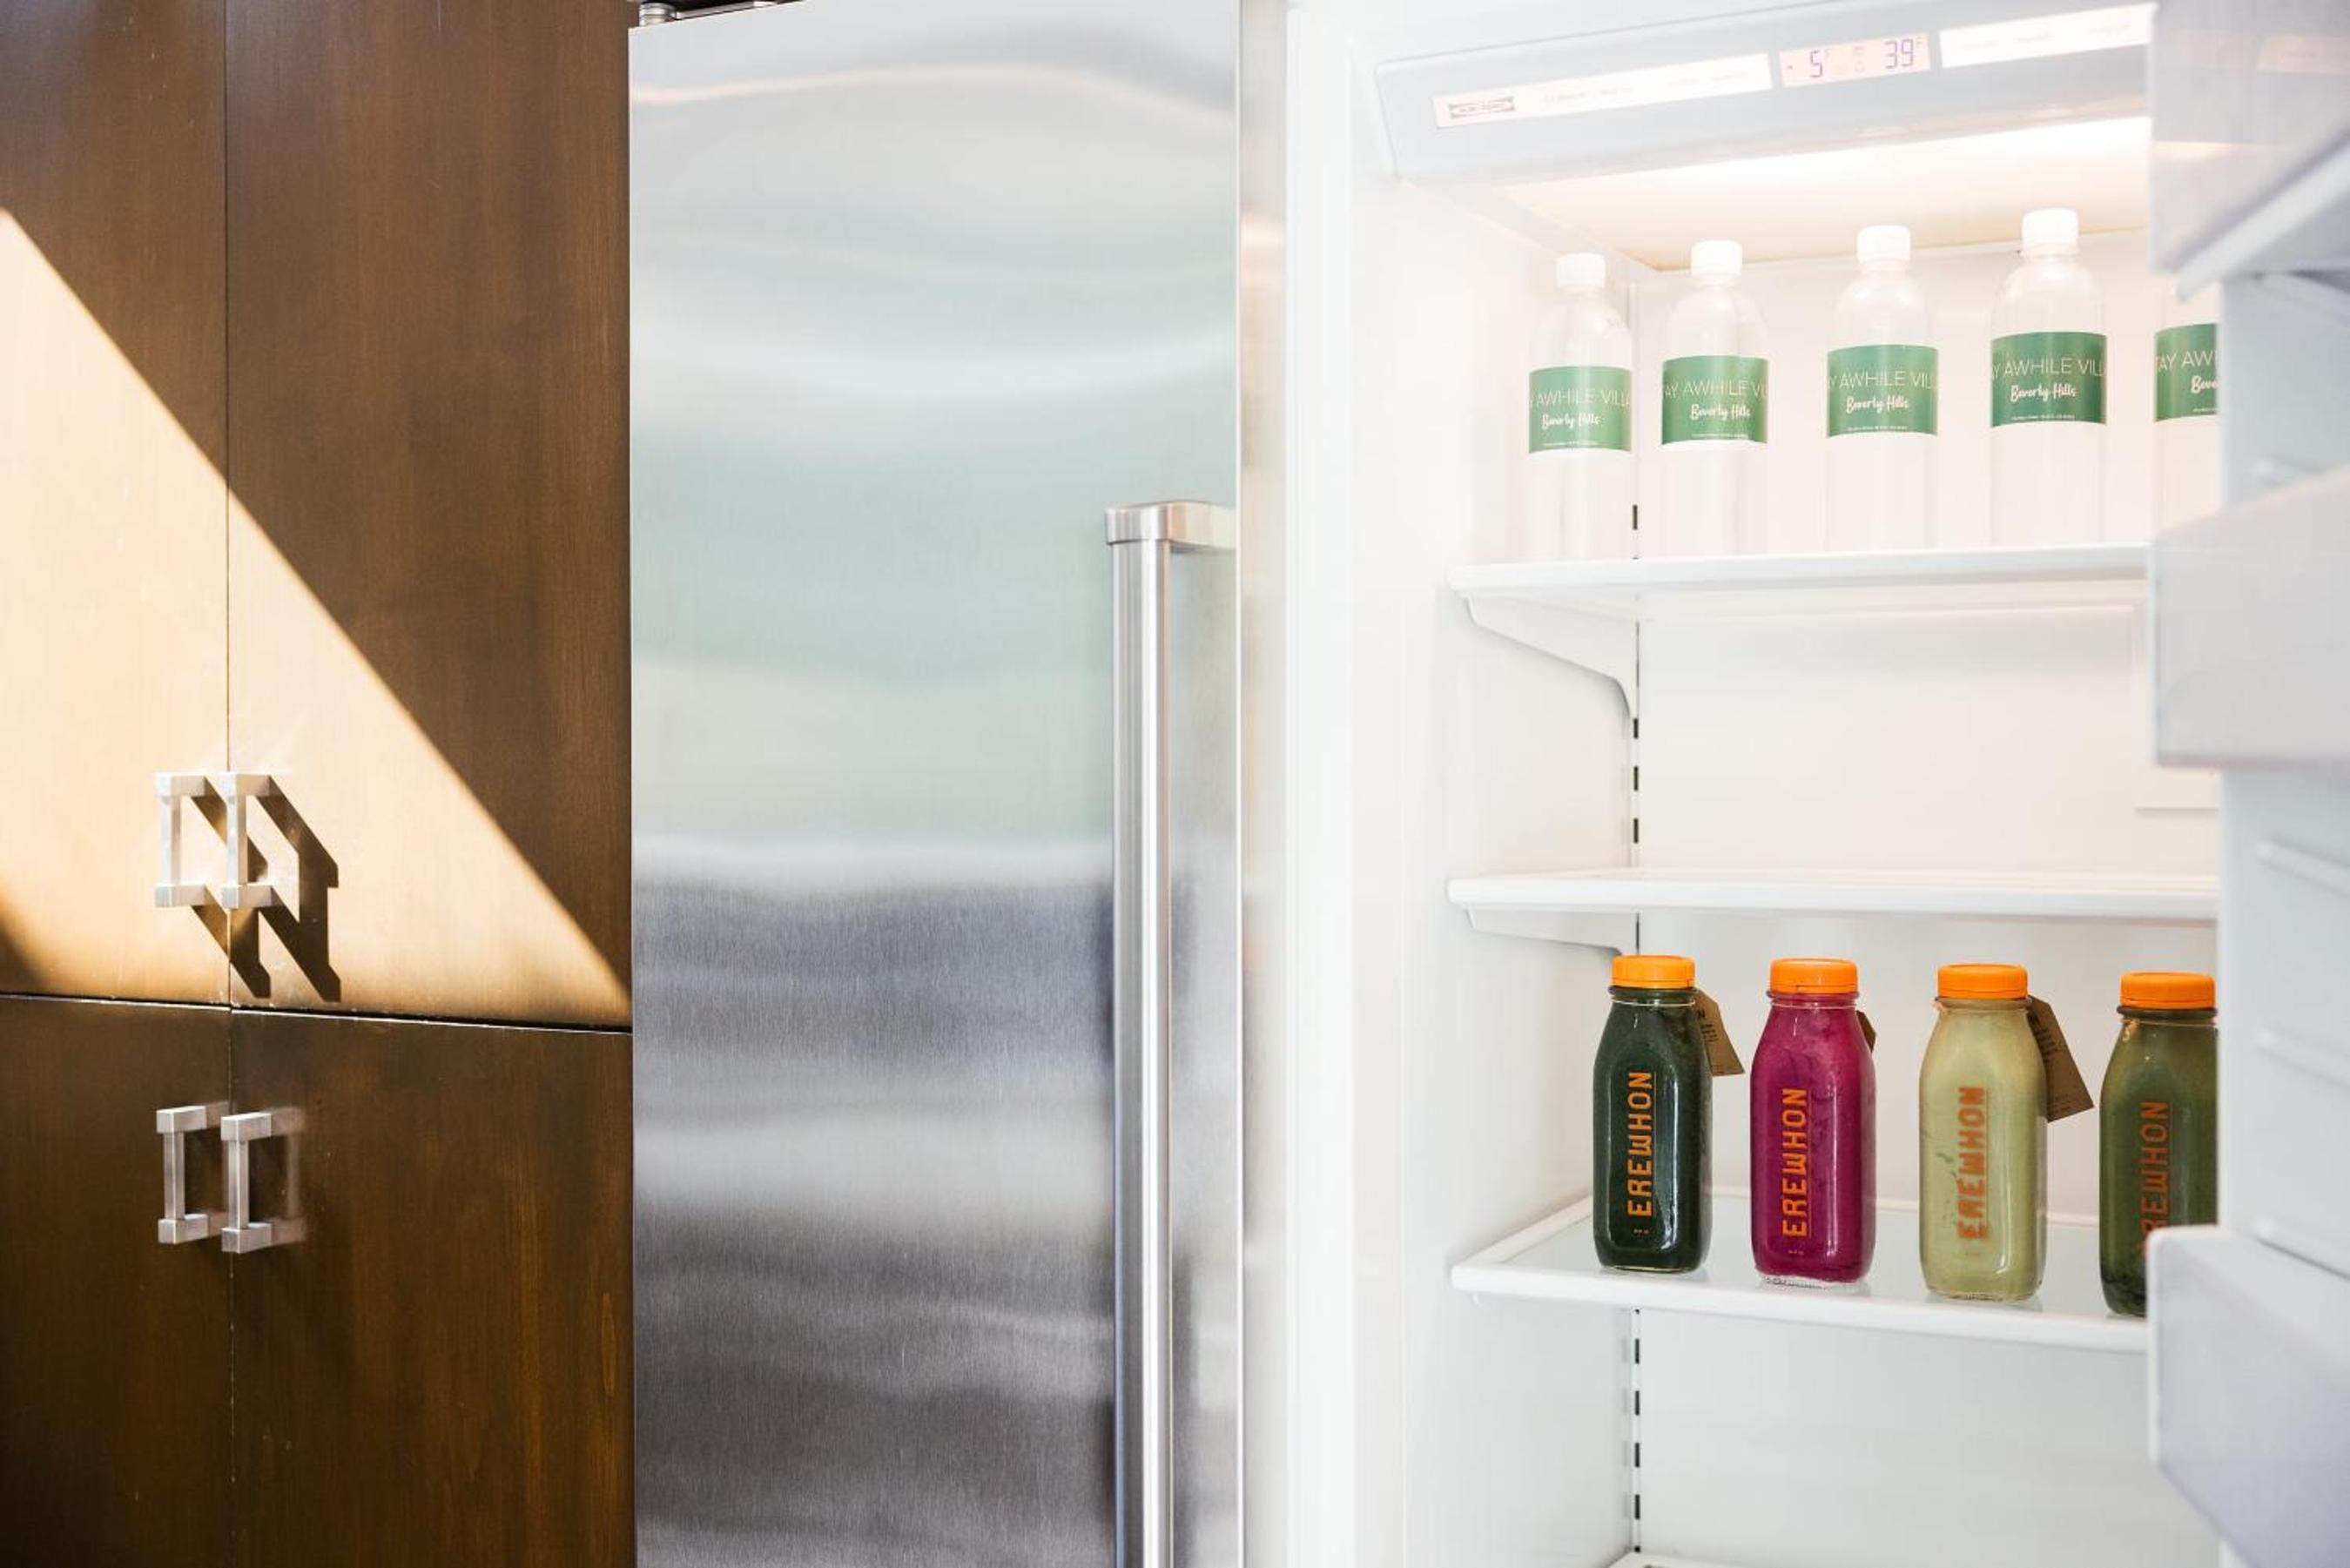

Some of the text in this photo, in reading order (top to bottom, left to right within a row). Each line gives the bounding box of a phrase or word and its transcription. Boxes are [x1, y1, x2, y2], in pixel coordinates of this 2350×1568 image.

[1883, 37, 1915, 70] 39
[2003, 356, 2072, 377] AWHILE
[1682, 378, 1748, 399] AWHILE
[1839, 368, 1906, 389] AWHILE
[1537, 388, 1595, 407] AWHILE
[2010, 382, 2077, 402] Beverly Hills
[1691, 403, 1750, 421] Beverly Hills
[1846, 394, 1909, 414] Beverly Hills
[1541, 413, 1574, 430] Beverly
[1627, 1072, 1653, 1217] EREWHON
[1782, 1089, 1808, 1237] EREWHON
[1957, 1087, 1986, 1240] EREWHON
